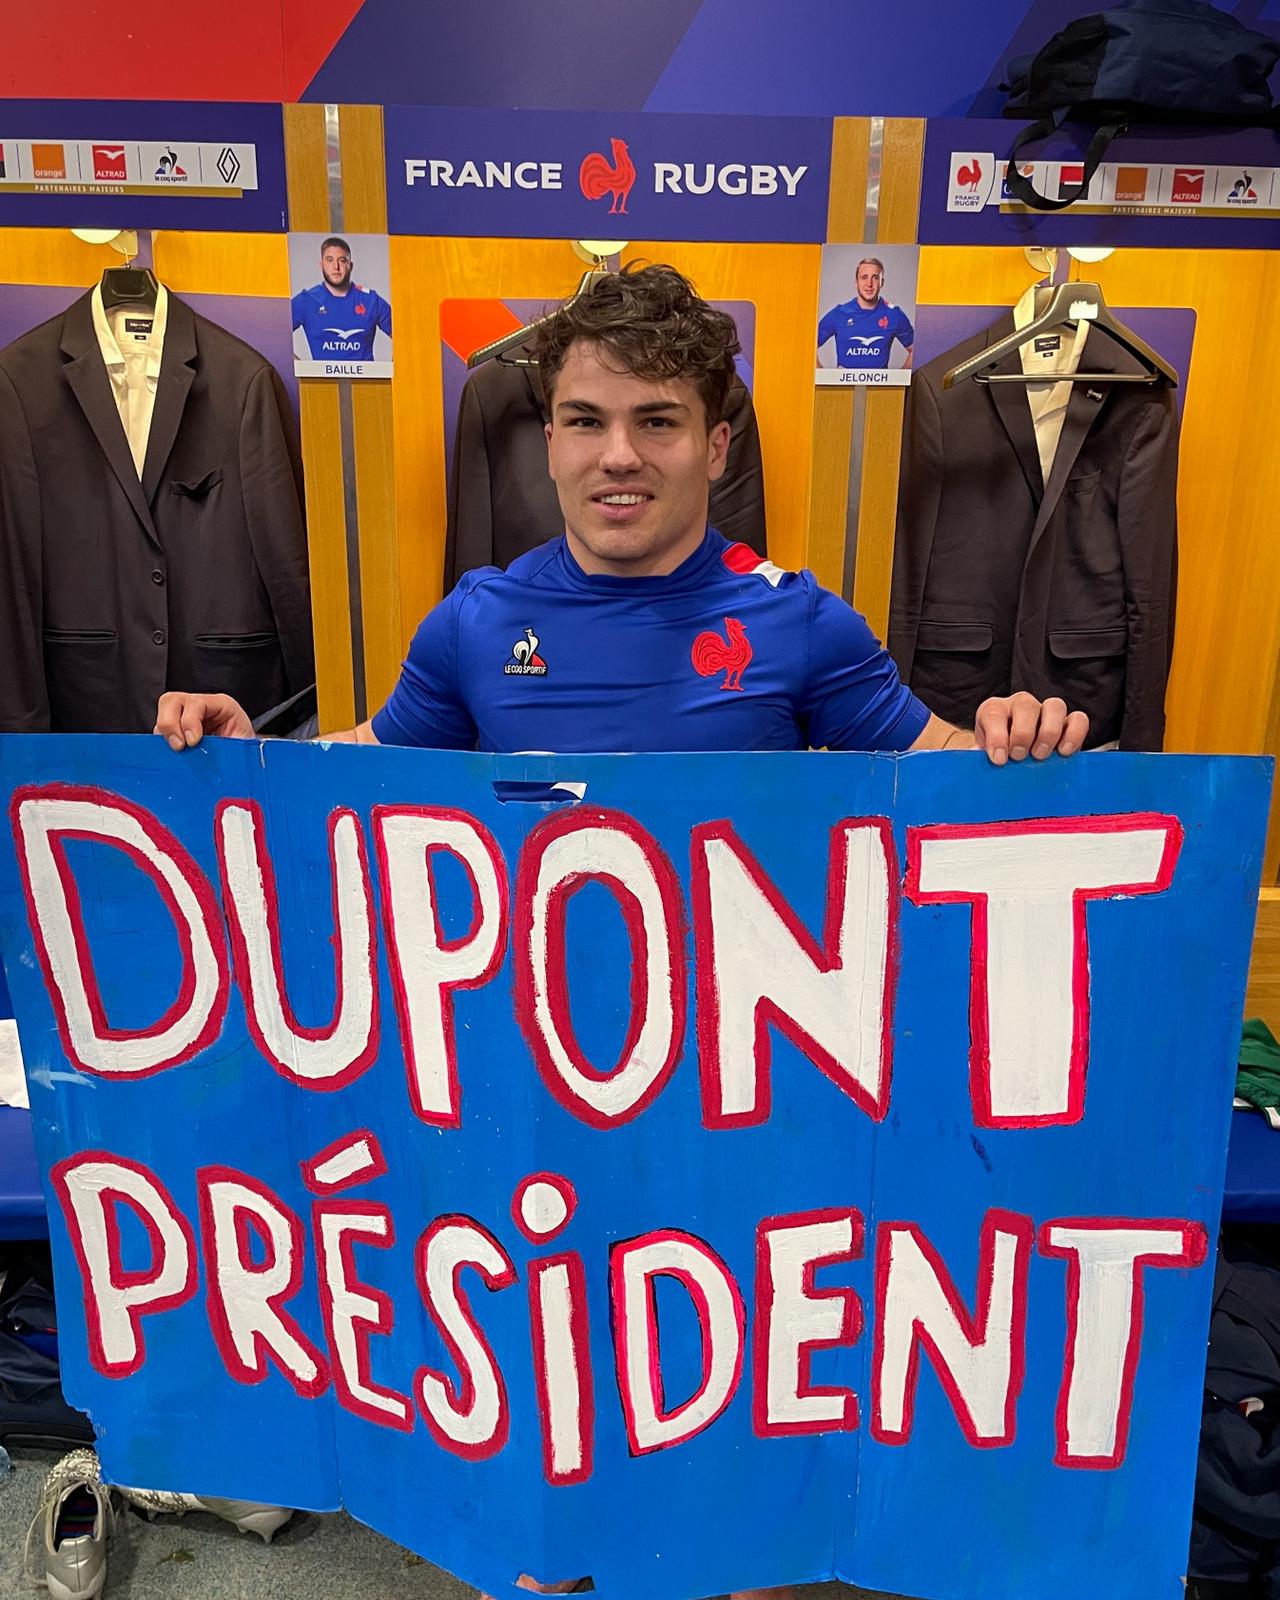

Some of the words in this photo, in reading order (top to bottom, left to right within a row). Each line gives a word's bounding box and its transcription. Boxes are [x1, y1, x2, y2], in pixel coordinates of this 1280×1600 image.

[35, 170, 64, 178] orange
[96, 170, 125, 178] ALTRAD
[404, 159, 562, 190] FRANCE
[653, 163, 808, 196] RUGBY
[34, 184, 87, 192] PARTENAIRES
[1116, 192, 1142, 200] orange
[1112, 206, 1161, 214] PARTENAIRES
[322, 342, 361, 351] ALTRAD
[846, 348, 880, 356] ALTRAD
[325, 365, 364, 374] BAILLE
[840, 373, 888, 382] JELONCH
[504, 665, 511, 673] LE
[511, 665, 522, 674] COQ
[523, 665, 547, 675] SPORTIF
[11, 782, 1184, 1131] DUPONT
